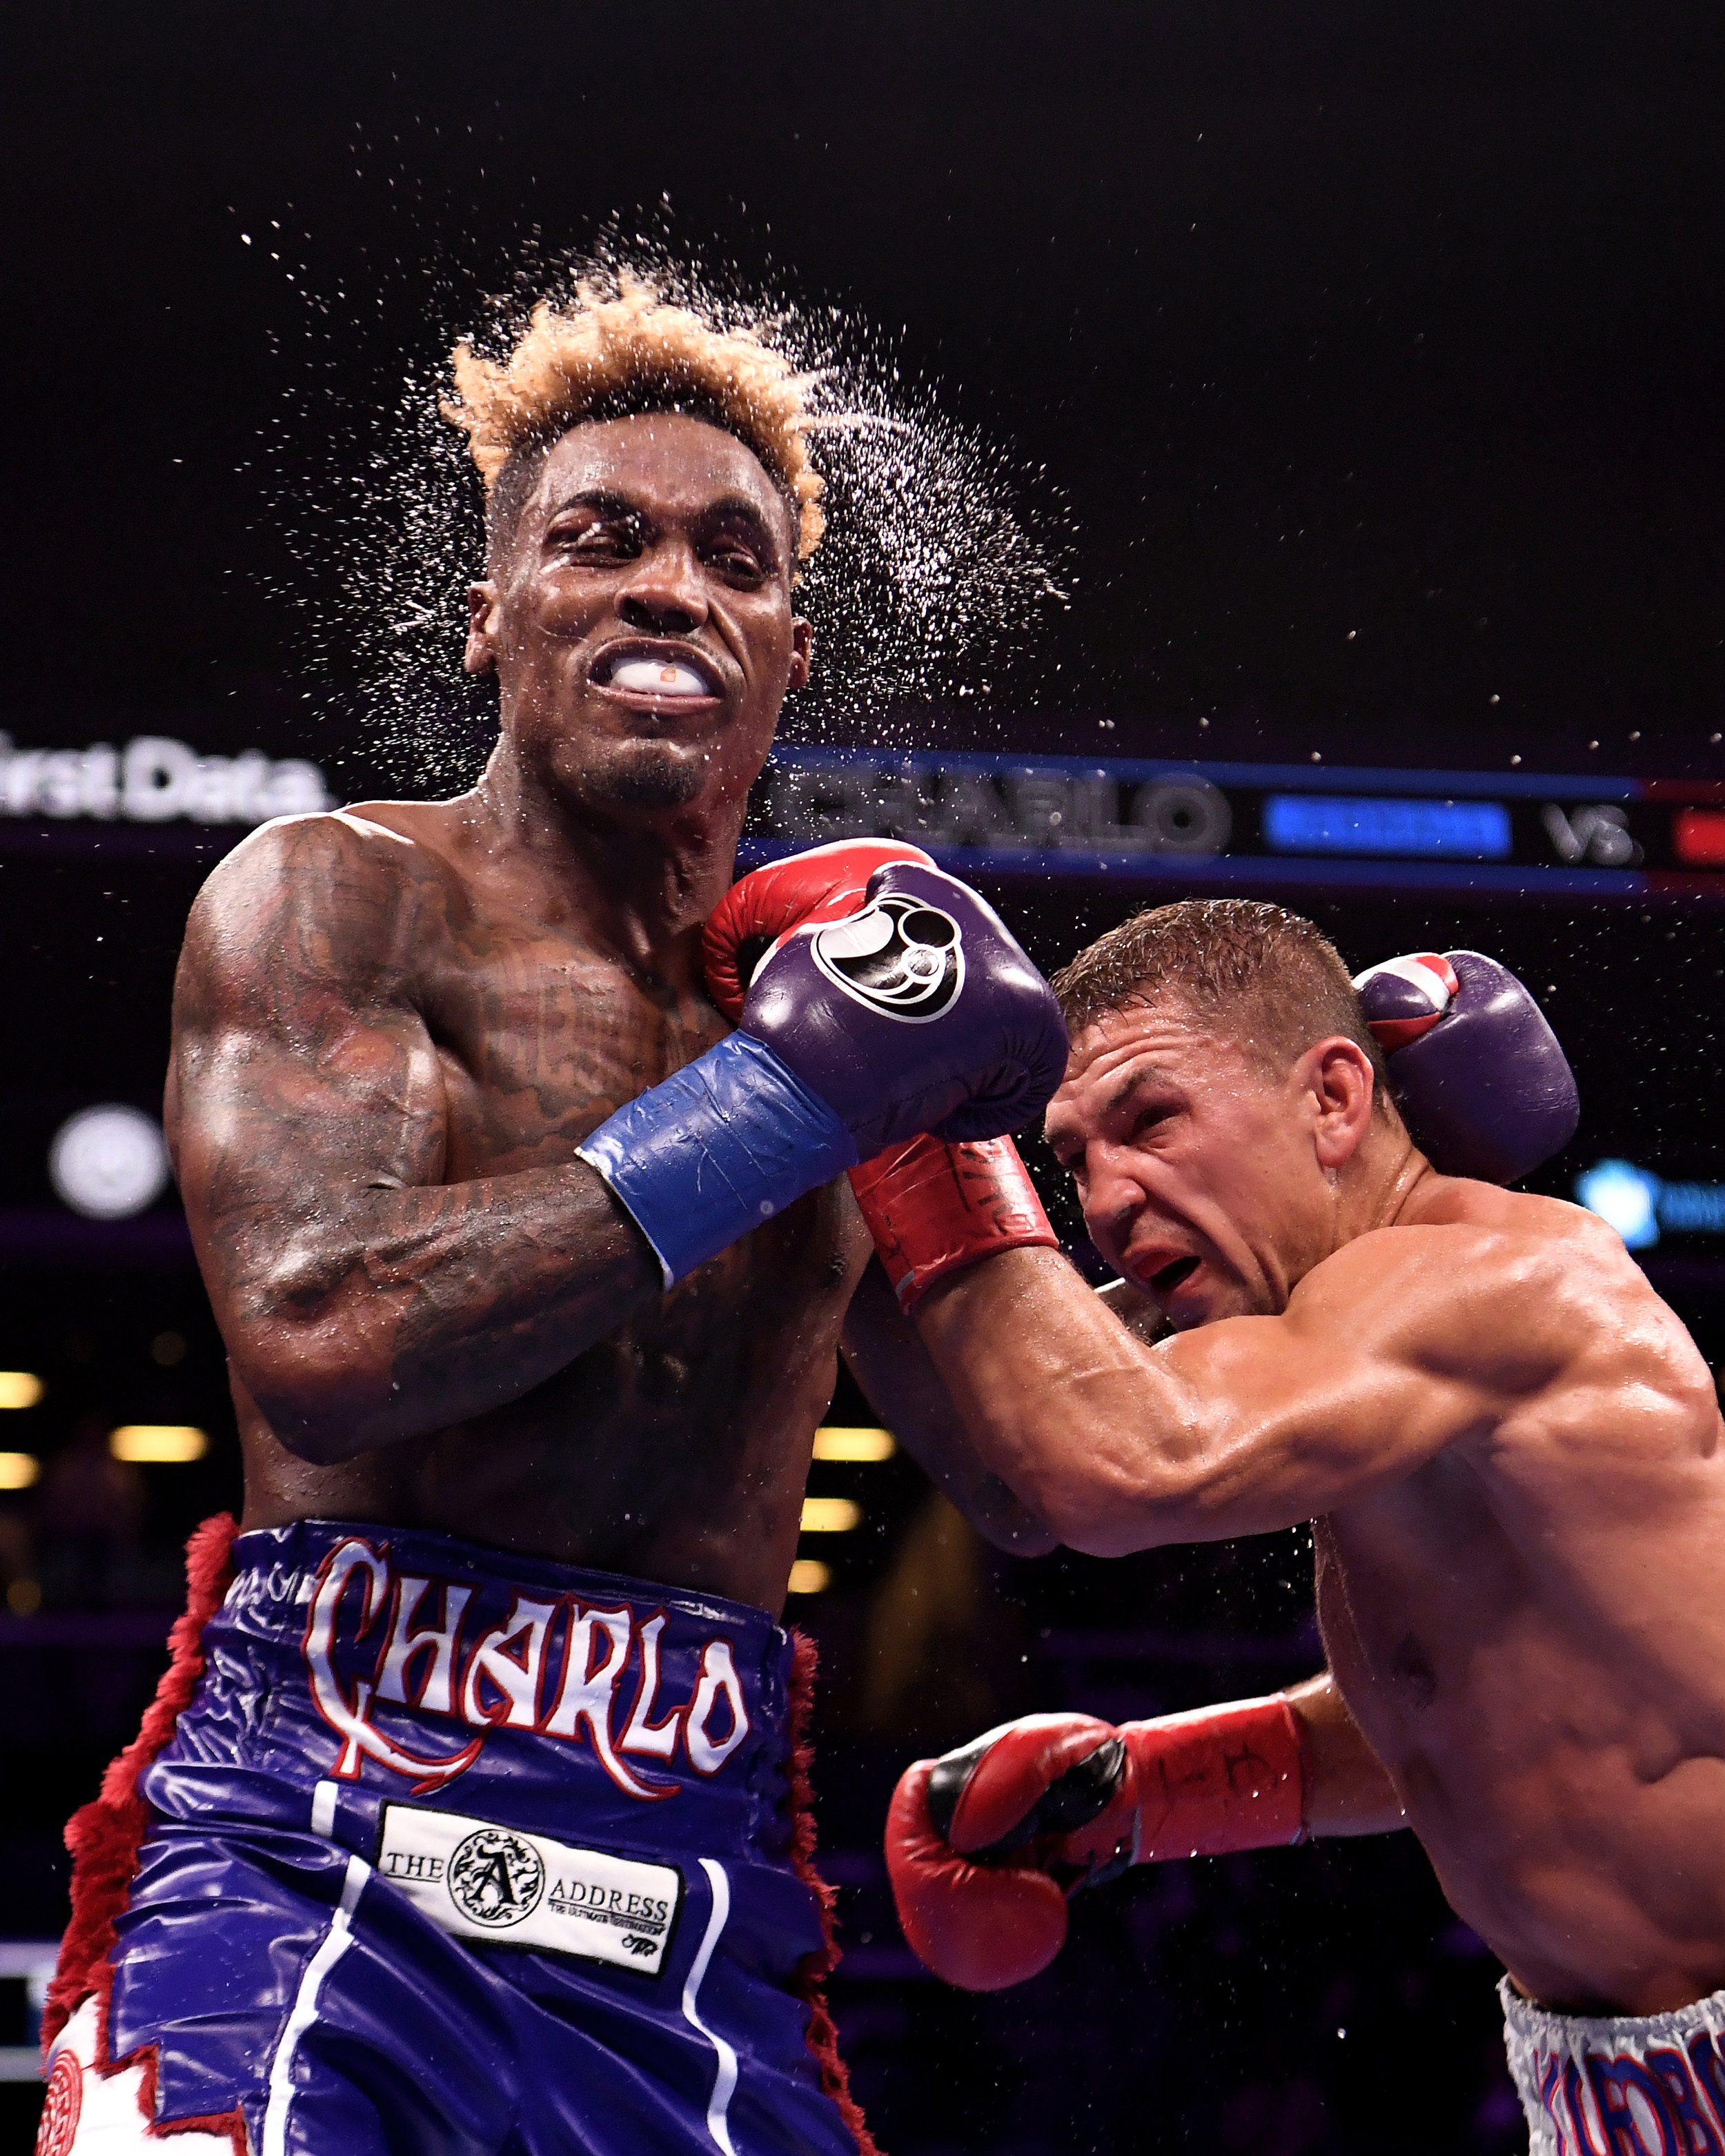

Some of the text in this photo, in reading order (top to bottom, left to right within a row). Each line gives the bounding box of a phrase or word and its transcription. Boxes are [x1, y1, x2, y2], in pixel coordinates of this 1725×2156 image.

[123, 735, 330, 825] Data
[769, 764, 1232, 861] CHARLO
[302, 1536, 751, 1801] CHARLO
[386, 1852, 669, 1922] THE ADDRESS
